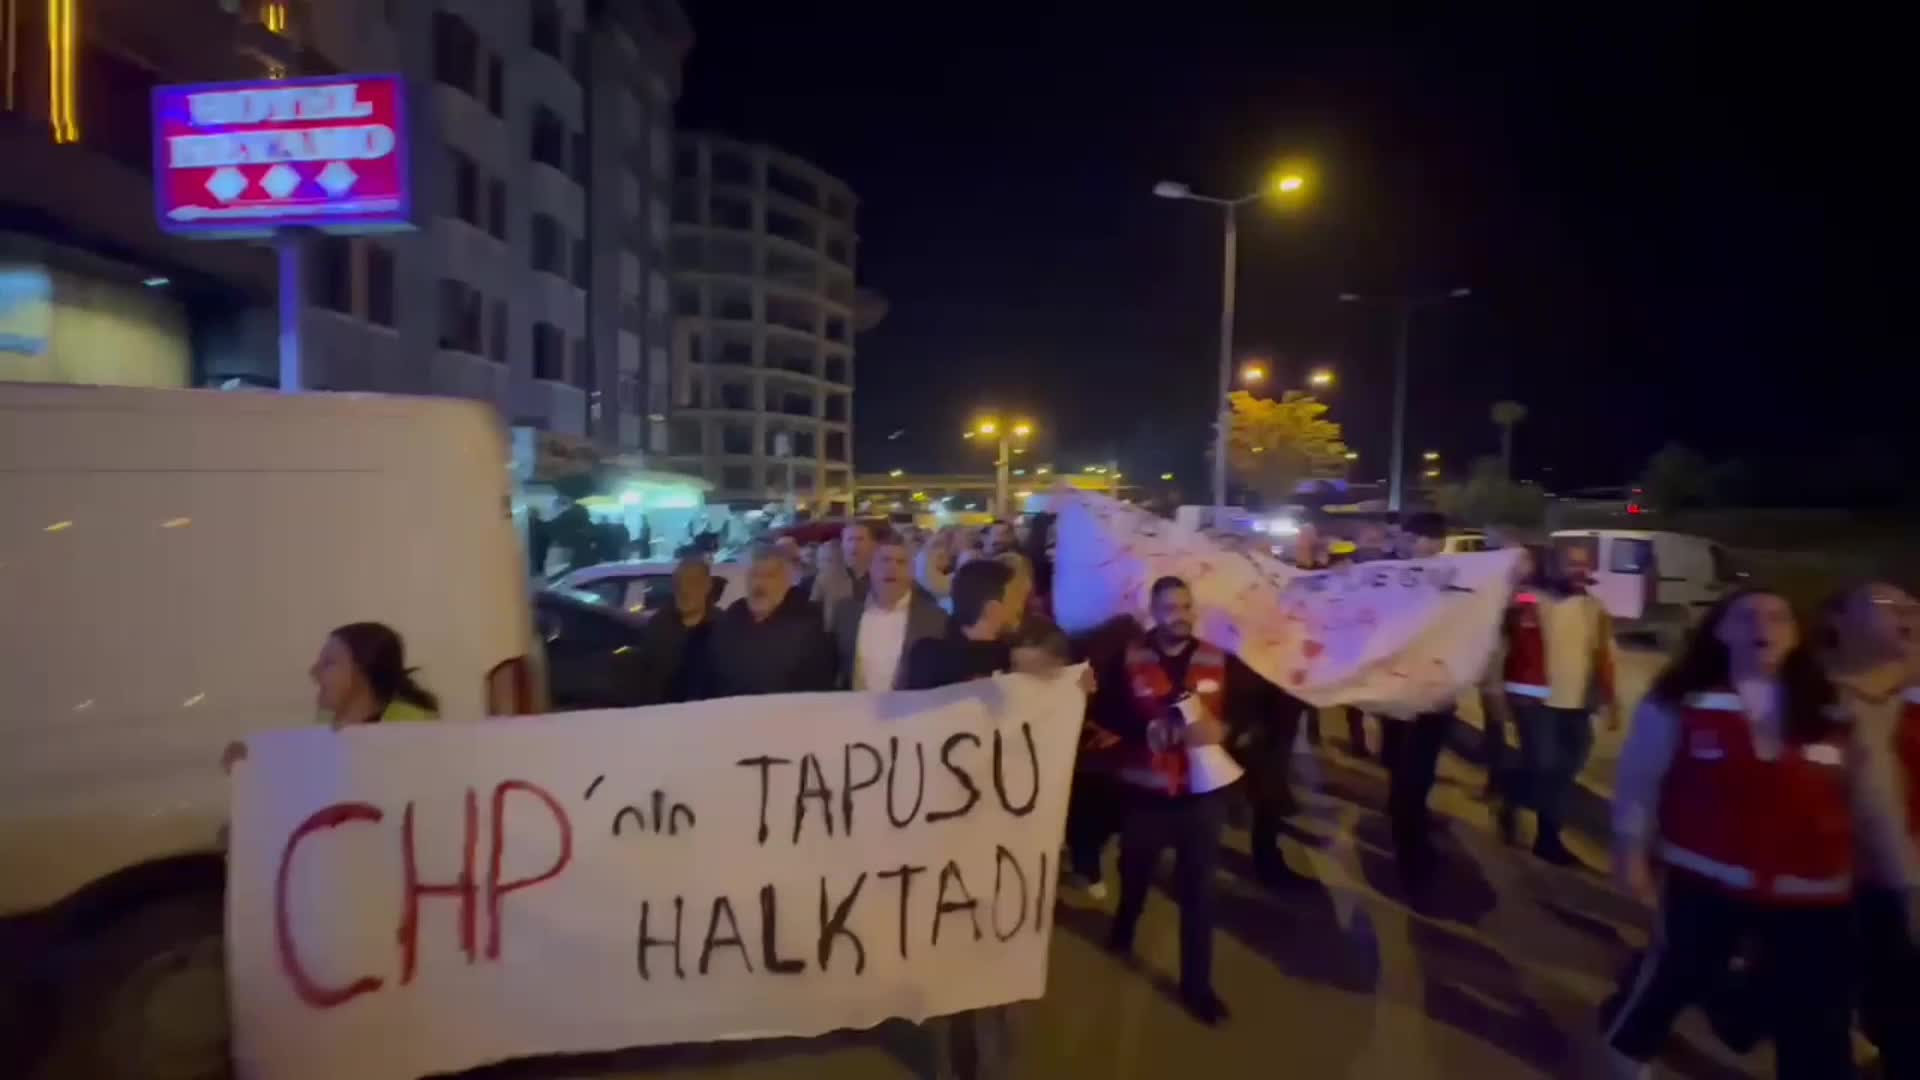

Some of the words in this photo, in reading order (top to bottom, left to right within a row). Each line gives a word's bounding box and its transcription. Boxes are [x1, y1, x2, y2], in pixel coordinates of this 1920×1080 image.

[188, 85, 373, 125] HOTEL
[738, 723, 1042, 847] TAPUSU
[638, 845, 1049, 981] HALKTADI
